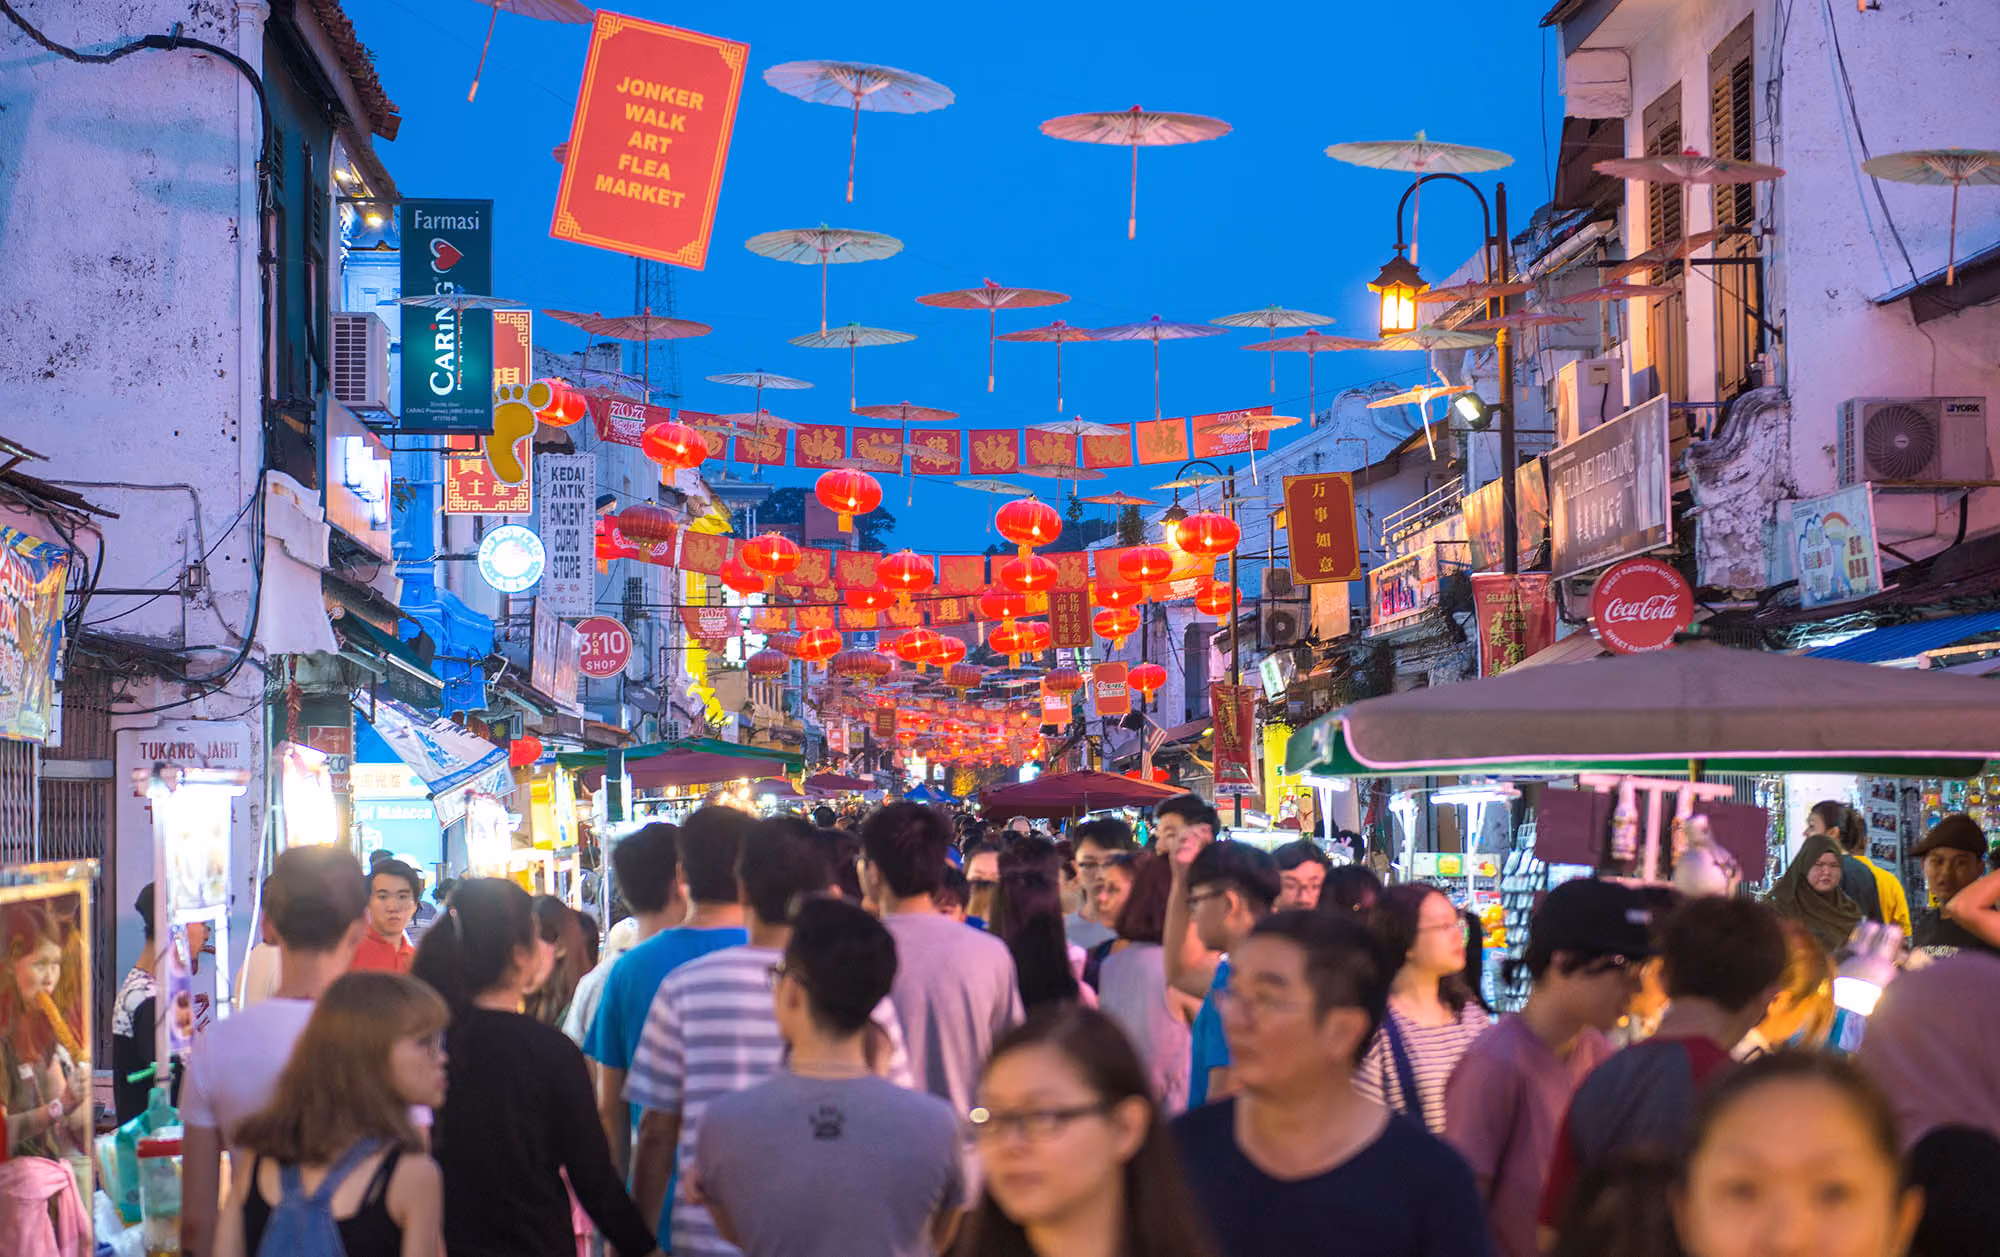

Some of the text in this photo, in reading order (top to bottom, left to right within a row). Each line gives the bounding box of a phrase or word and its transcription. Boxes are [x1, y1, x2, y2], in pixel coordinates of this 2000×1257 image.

[616, 76, 704, 111] JONKER
[625, 103, 686, 132] WALK
[628, 131, 672, 154] ART
[618, 154, 671, 181] FLEA
[595, 174, 685, 208] MARKET
[414, 210, 480, 230] Farmasi
[1956, 404, 1980, 412] YORK
[551, 467, 585, 481] KEDAI
[551, 484, 585, 499] ANTIK
[550, 503, 586, 526] ANCIENT
[1311, 482, 1335, 573] 万事如意
[554, 530, 579, 553] CURIO
[553, 555, 581, 579] STORE
[1601, 565, 1681, 595] SWEET RAINBOW HOUSE
[1604, 594, 1681, 624] Coca-Cola
[592, 633, 600, 656] FOR
[600, 631, 625, 654] 10
[586, 660, 617, 670] SHOP
[140, 742, 240, 760] TUKANG JAHIT
